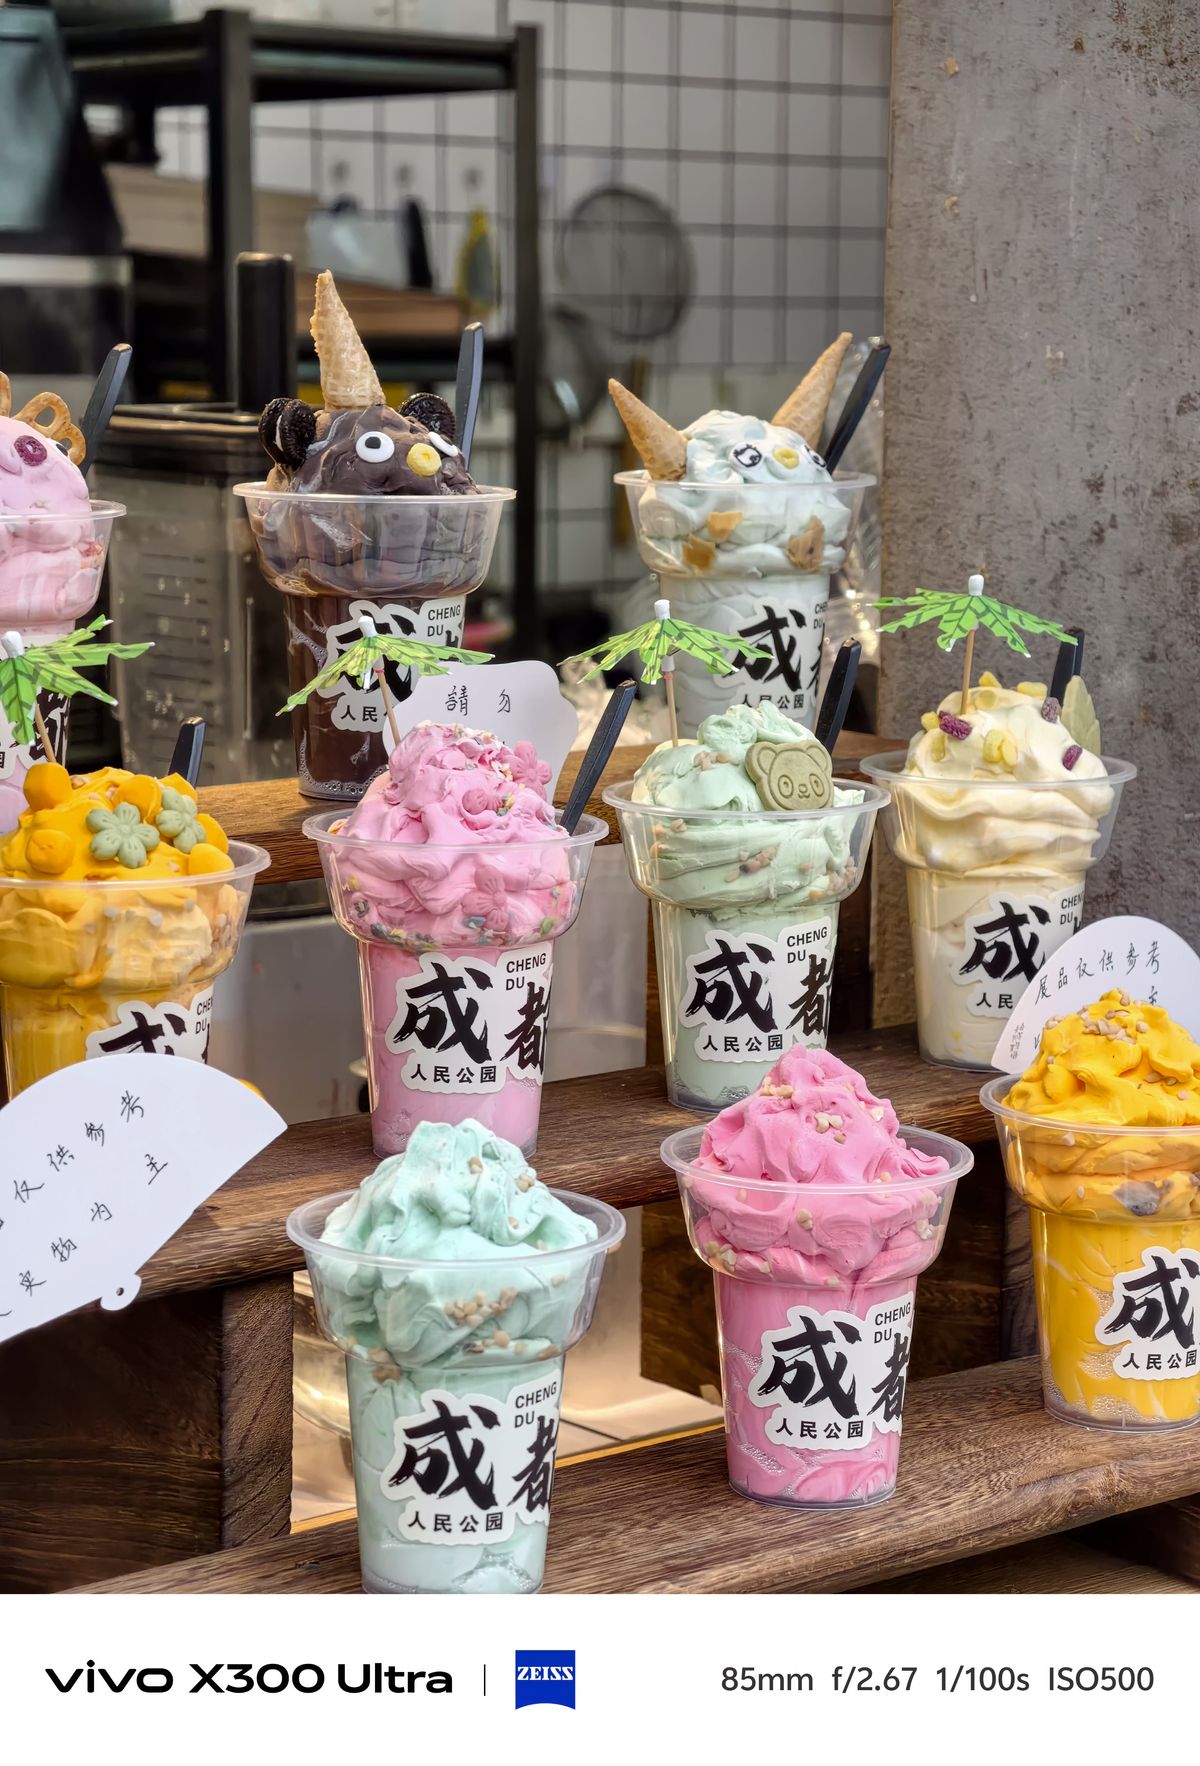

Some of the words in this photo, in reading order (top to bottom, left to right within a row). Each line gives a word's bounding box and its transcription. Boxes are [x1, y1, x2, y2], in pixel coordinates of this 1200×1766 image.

[428, 605, 461, 621] CHENG
[427, 625, 444, 637] DU
[340, 706, 388, 723] 人民
[1060, 911, 1074, 925] DU
[787, 927, 827, 948] CHENG
[959, 901, 1082, 983] 成
[506, 953, 546, 974] CHENG
[787, 950, 806, 964] DU
[1035, 941, 1160, 1005] 展品仅供参考
[505, 977, 525, 991] DU
[976, 993, 1014, 1009] 人民
[195, 1018, 207, 1034] DU
[703, 1034, 783, 1052] 人民公园
[411, 1064, 497, 1084] 人民公园
[0, 1090, 144, 1230] 仅供参考
[0, 1154, 168, 1316] 实物为主
[1104, 1255, 1200, 1350] 成
[874, 1302, 911, 1326] CHENG
[874, 1328, 893, 1344] DU
[1122, 1349, 1198, 1371] 人民公园
[515, 1381, 557, 1409] CHENG
[514, 1411, 535, 1428] DU
[776, 1418, 864, 1440] 人民公园
[408, 1511, 503, 1533] 人民公园
